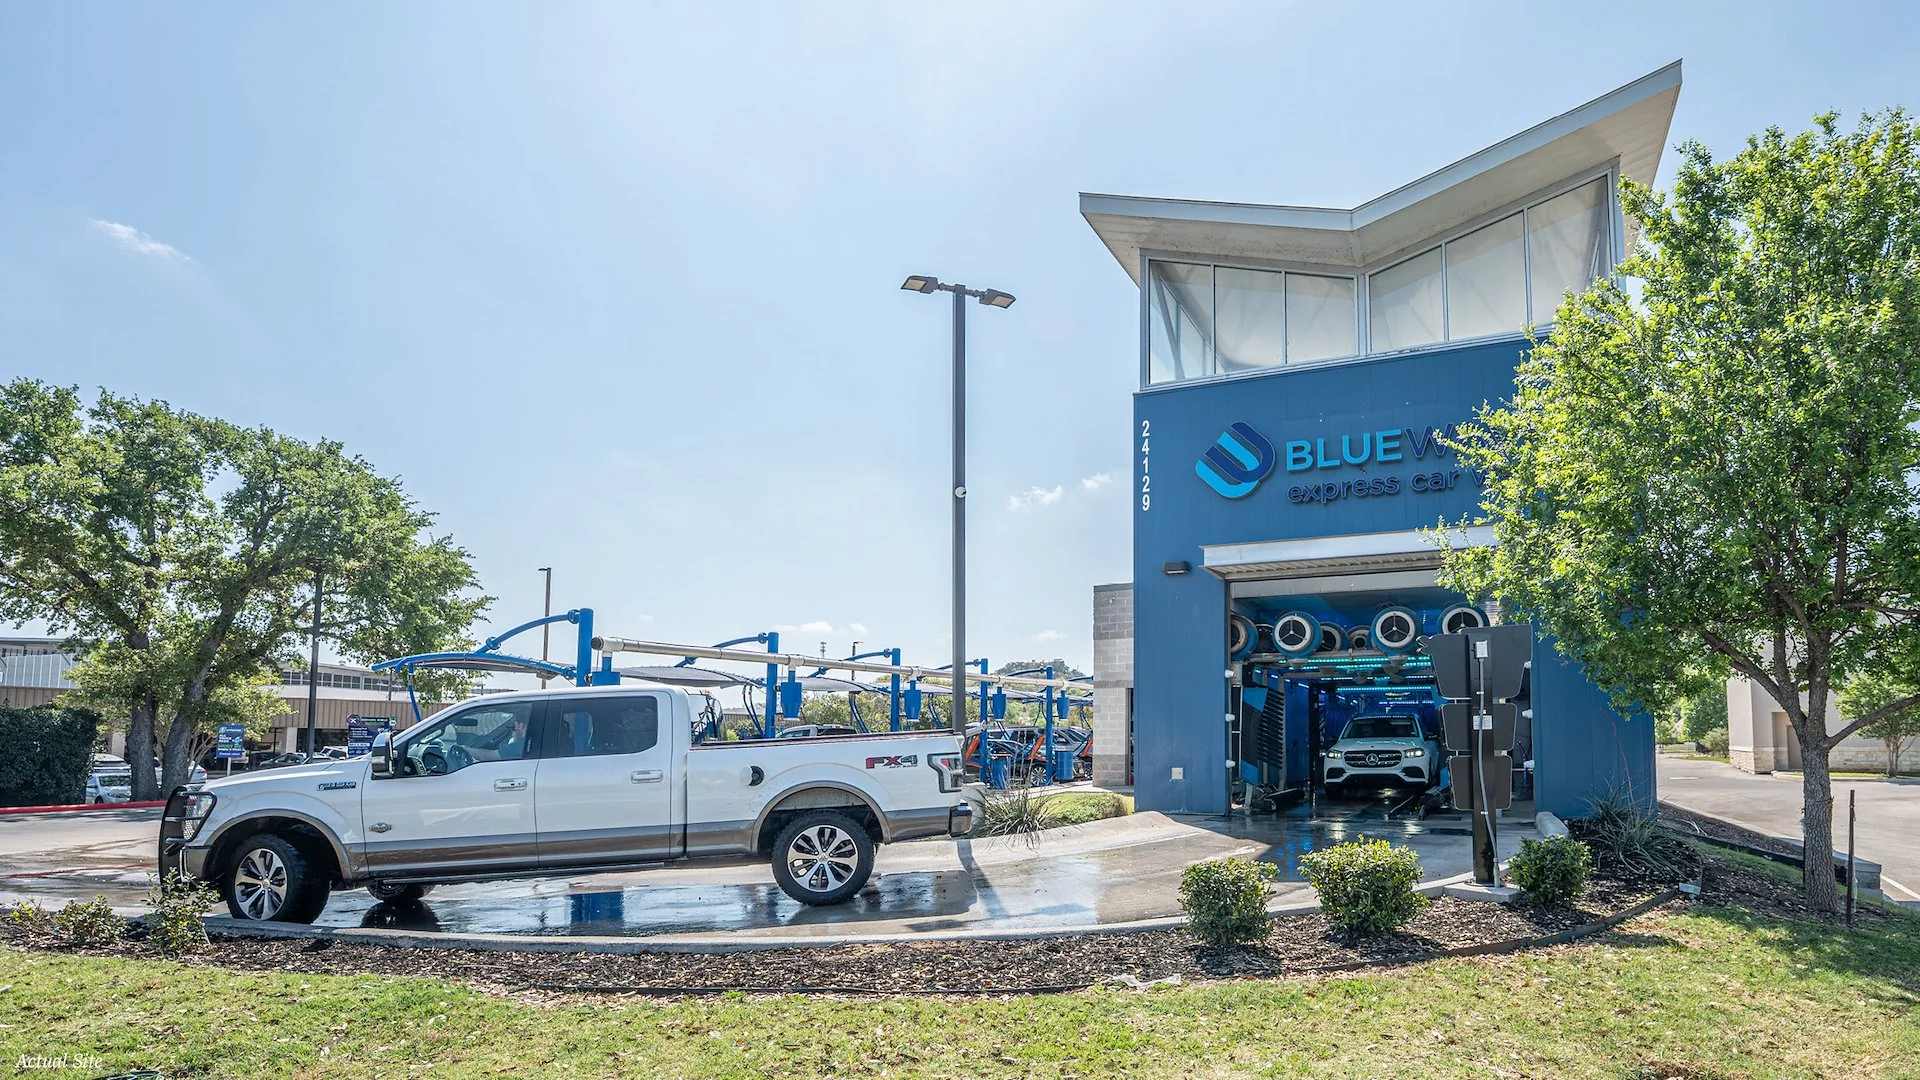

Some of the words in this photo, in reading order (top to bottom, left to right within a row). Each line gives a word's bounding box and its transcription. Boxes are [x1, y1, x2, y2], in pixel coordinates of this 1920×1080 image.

[1141, 419, 1151, 512] 24129
[1286, 421, 1500, 472] BLUEW
[1286, 475, 1400, 504] express
[1410, 469, 1460, 492] car
[865, 754, 919, 769] FX4
